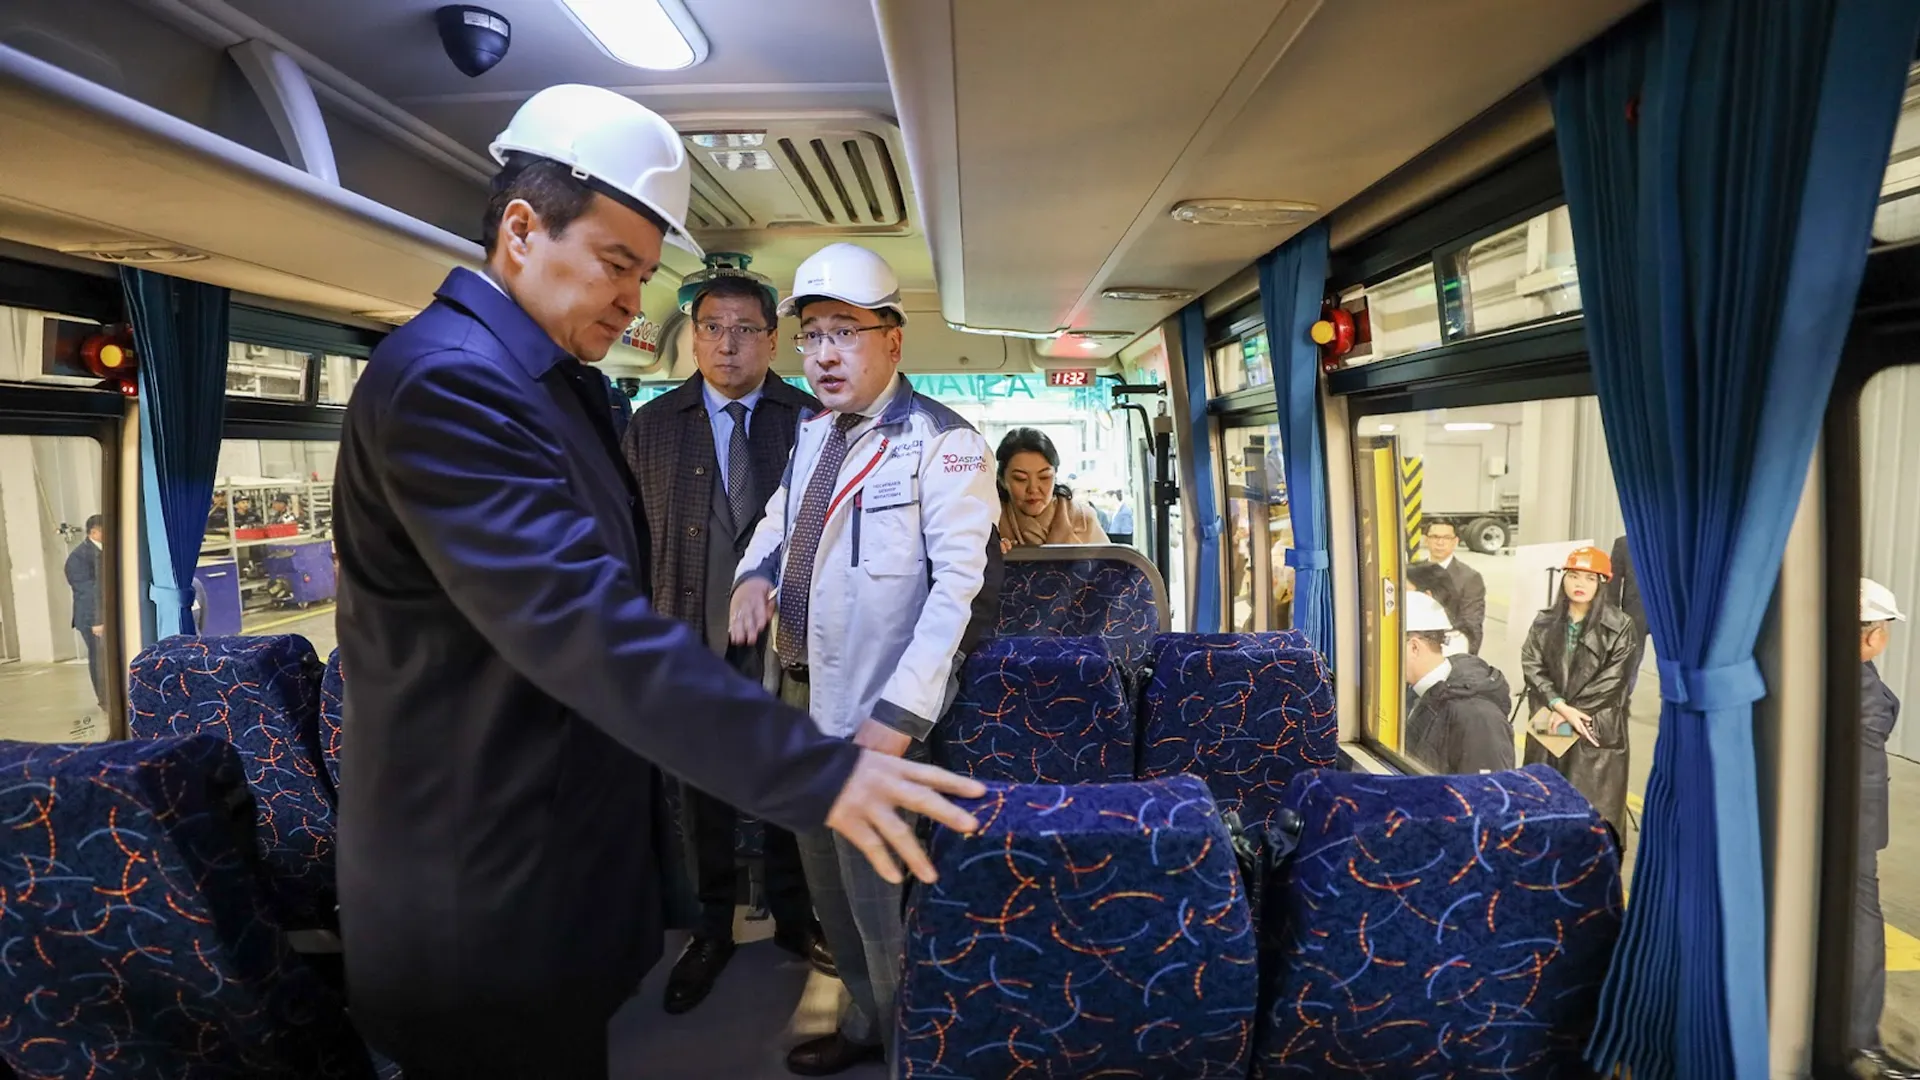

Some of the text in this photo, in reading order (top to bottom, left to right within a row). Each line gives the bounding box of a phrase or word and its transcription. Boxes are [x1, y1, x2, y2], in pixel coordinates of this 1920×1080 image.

[1055, 371, 1086, 386] 11:32
[943, 453, 958, 465] 30
[944, 462, 988, 474] MOTORS
